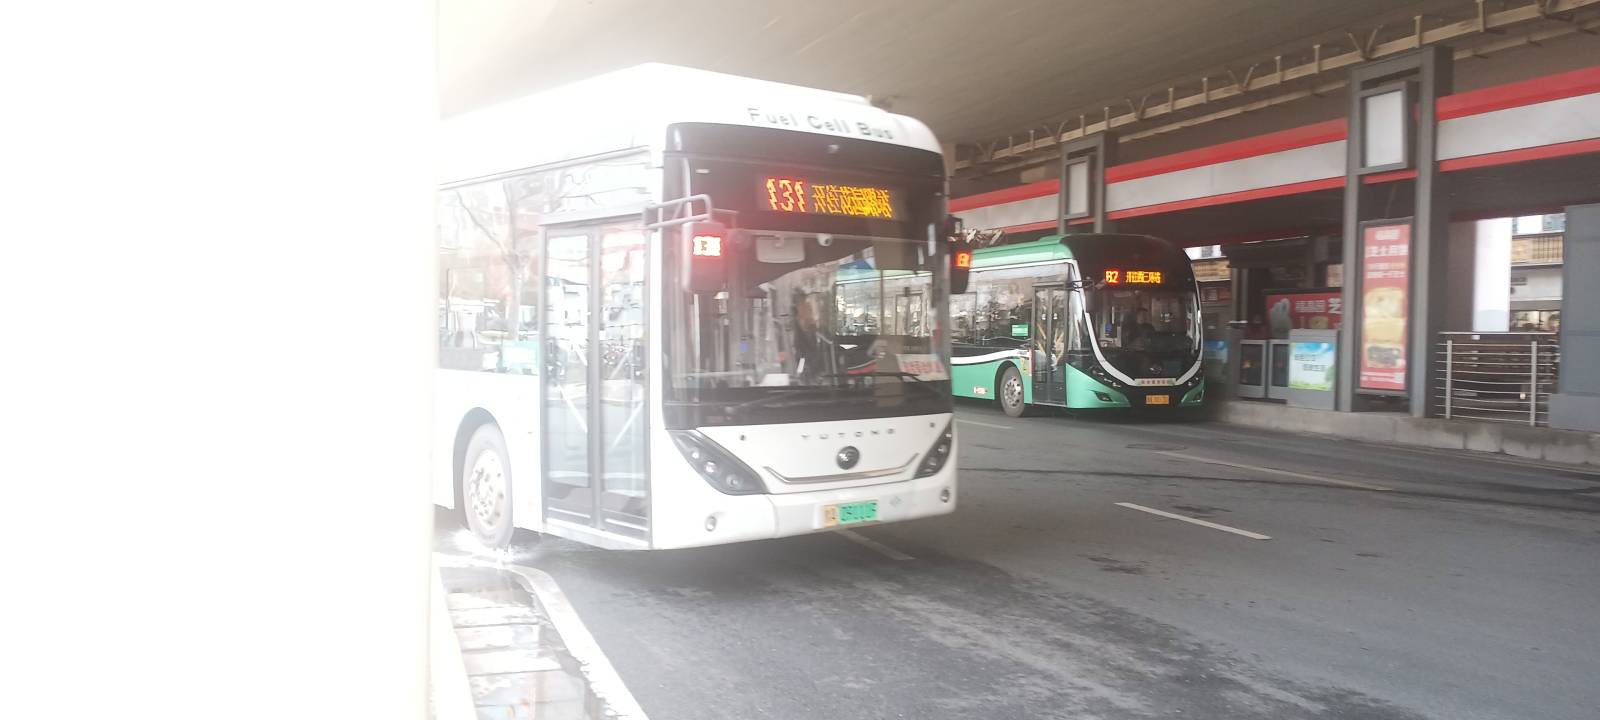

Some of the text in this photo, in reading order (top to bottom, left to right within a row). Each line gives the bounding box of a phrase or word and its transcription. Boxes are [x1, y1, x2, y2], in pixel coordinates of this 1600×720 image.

[748, 107, 893, 139] Fuel Cell Bus
[766, 178, 806, 213] 131
